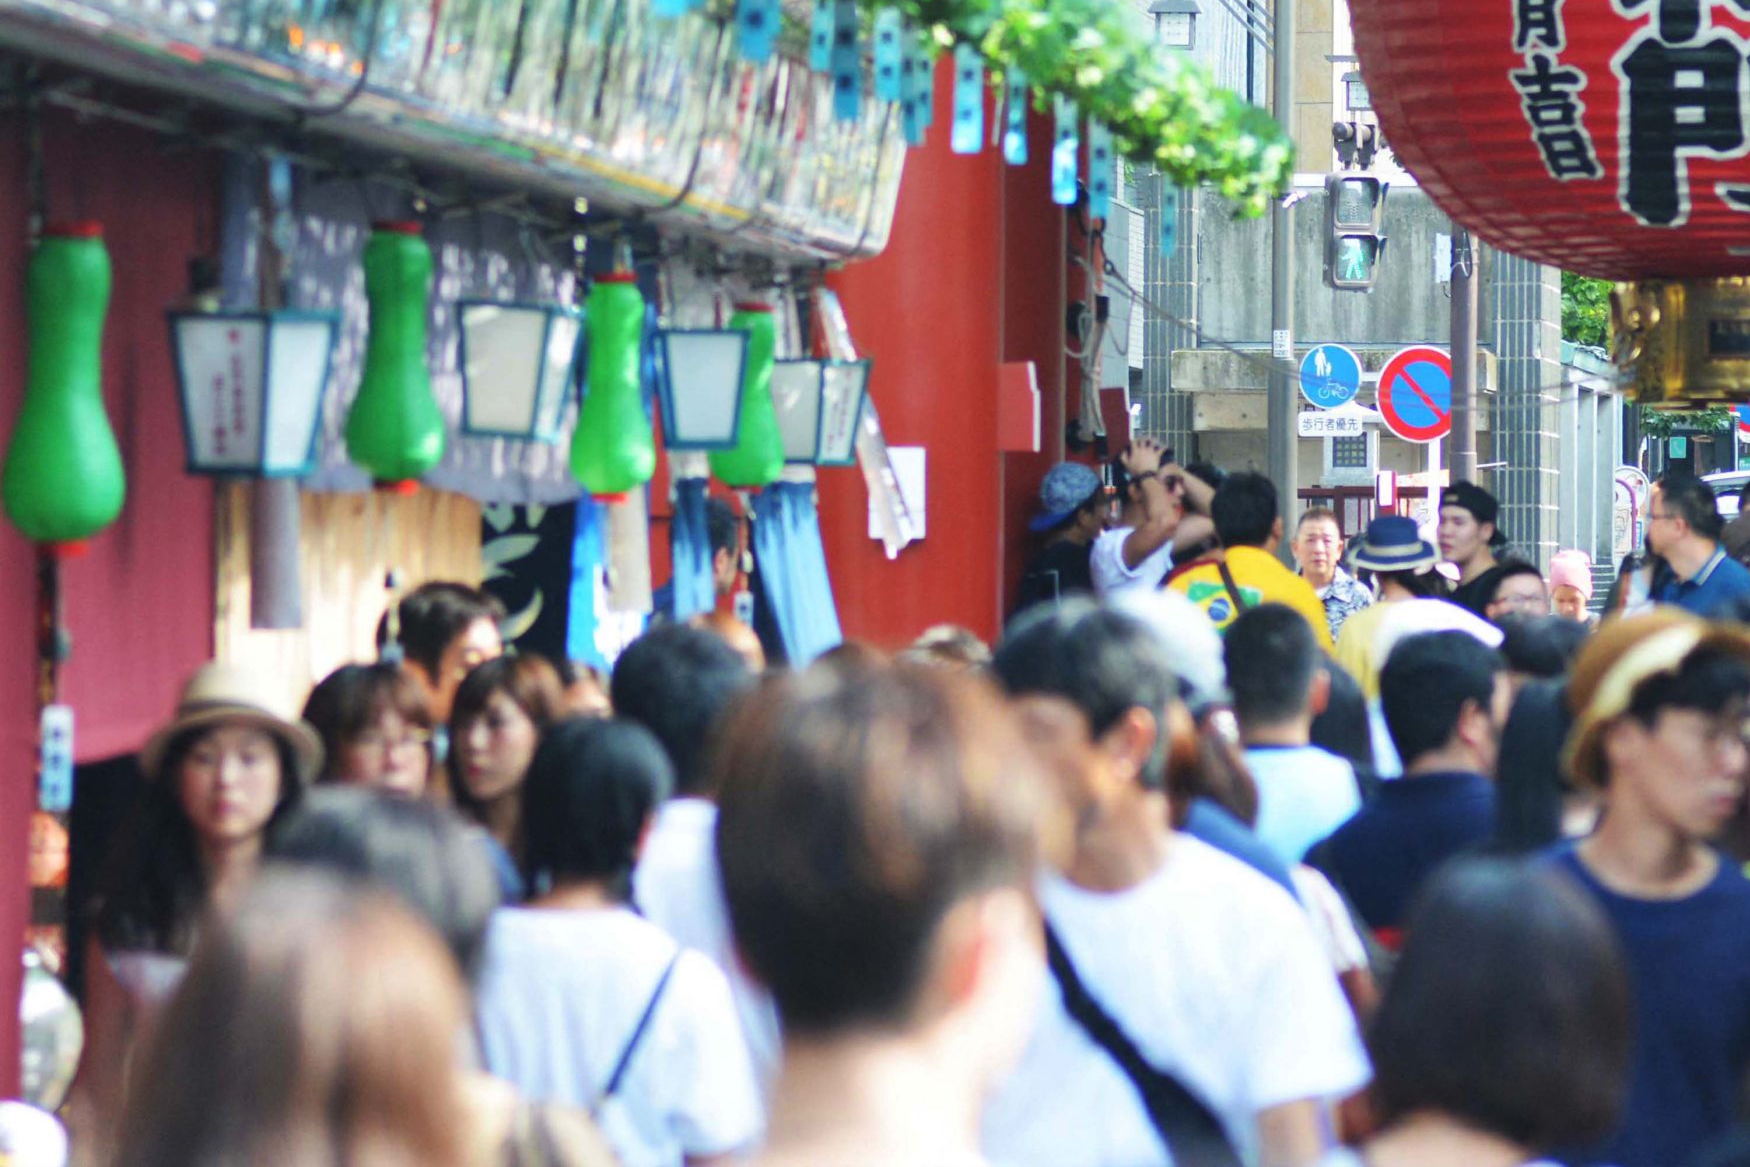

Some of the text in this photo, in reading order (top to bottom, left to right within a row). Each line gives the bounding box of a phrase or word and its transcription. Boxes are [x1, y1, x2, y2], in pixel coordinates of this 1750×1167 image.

[1302, 417, 1359, 431] 歩行者優先
